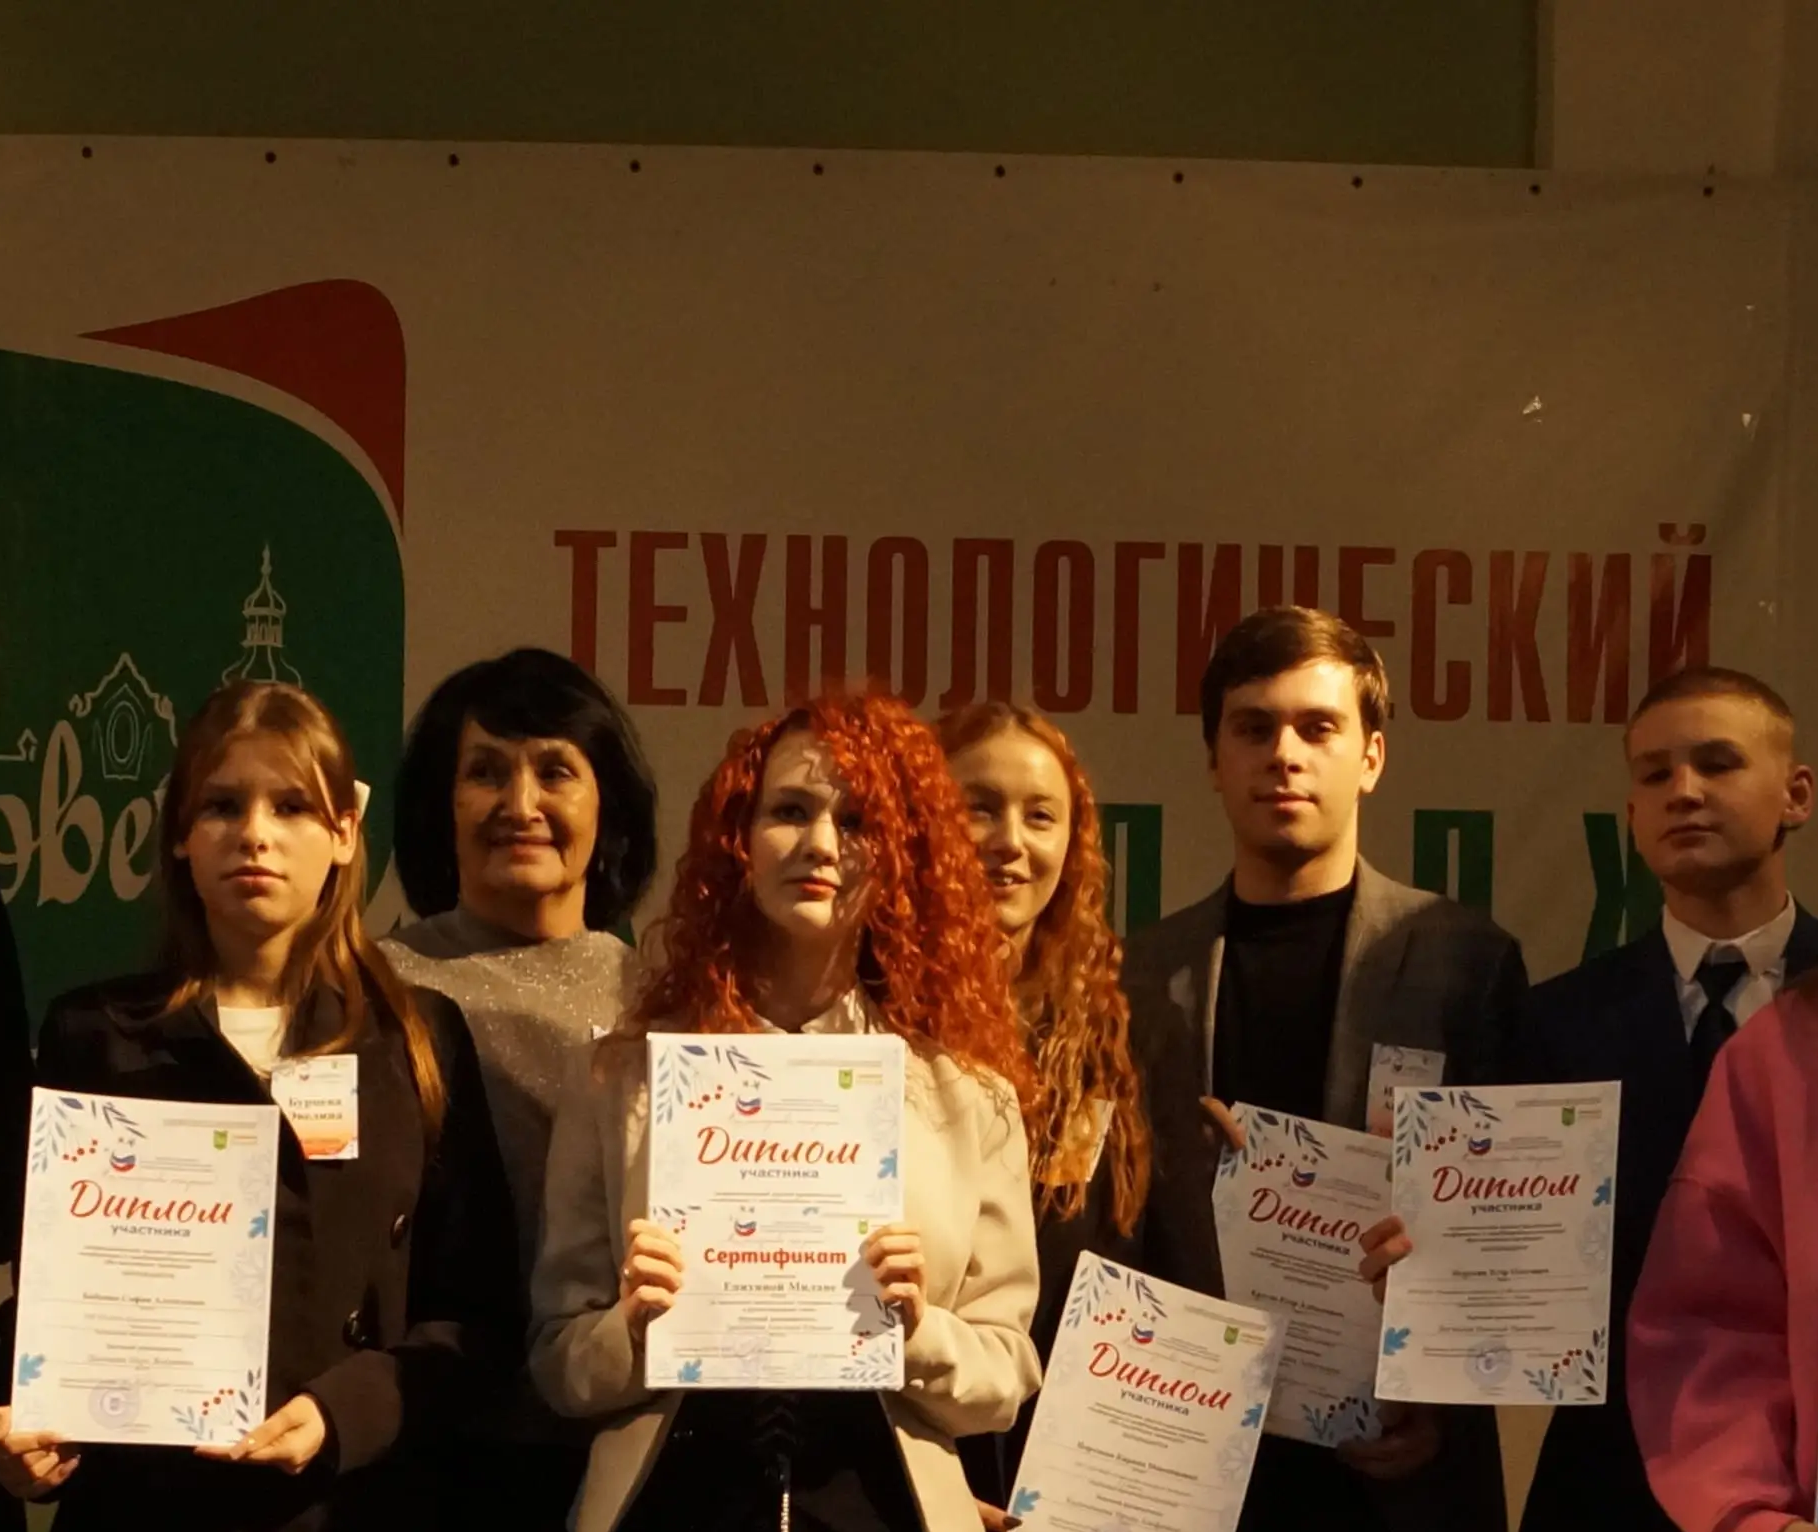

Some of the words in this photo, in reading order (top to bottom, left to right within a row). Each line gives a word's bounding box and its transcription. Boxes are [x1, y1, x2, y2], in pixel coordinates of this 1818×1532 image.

[697, 1125, 862, 1165] Диплом
[739, 1167, 820, 1180] участника
[1432, 1166, 1581, 1203] Диплом
[69, 1179, 234, 1225] Диплом
[1248, 1187, 1364, 1243] Дипло
[110, 1224, 192, 1239] участника
[703, 1247, 848, 1271] Сертификат
[1087, 1341, 1233, 1412] Диплом
[1120, 1388, 1190, 1417] участника
